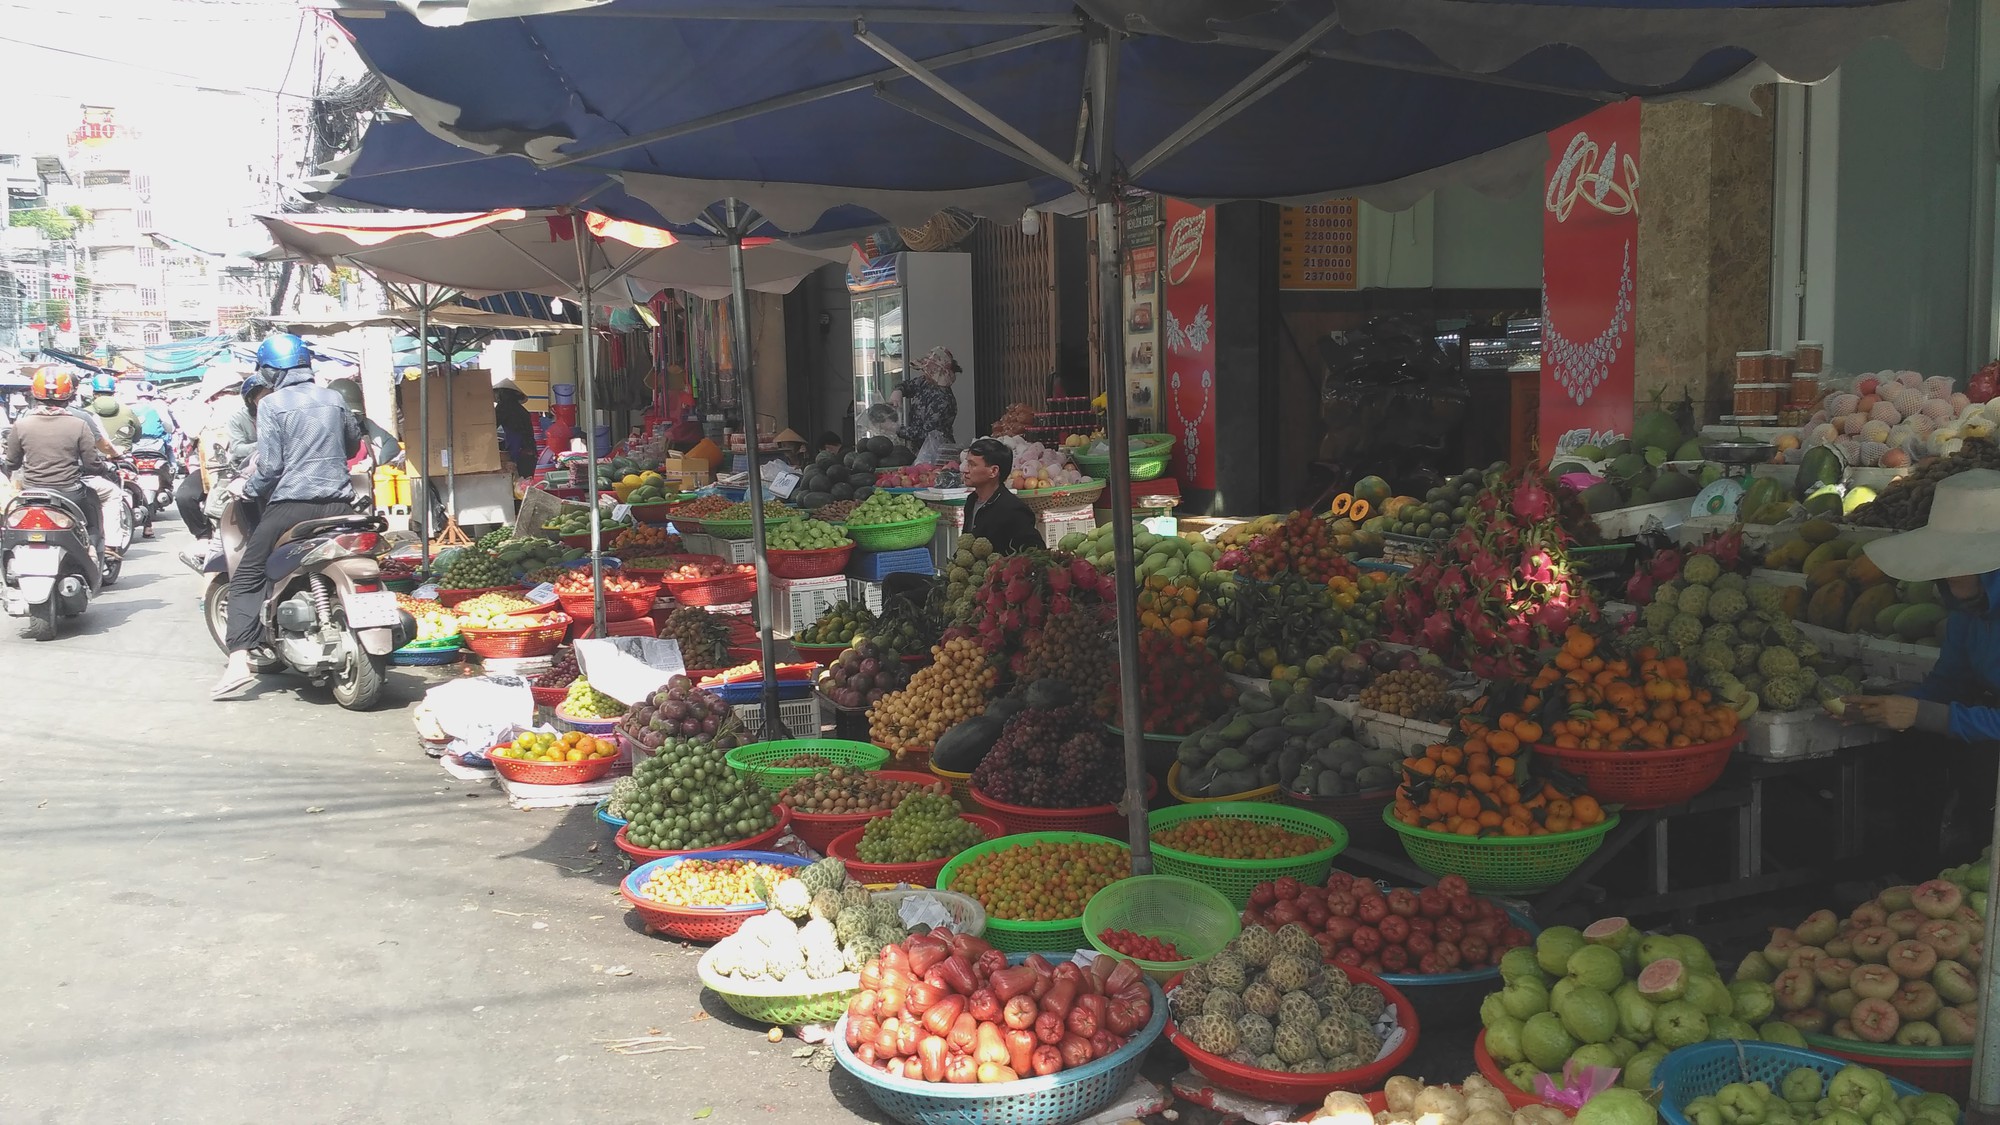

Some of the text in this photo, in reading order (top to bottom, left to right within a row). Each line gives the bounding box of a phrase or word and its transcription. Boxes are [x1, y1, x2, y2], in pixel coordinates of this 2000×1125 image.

[1304, 205, 1353, 215] 2600000
[1305, 218, 1353, 228] 2800000
[1304, 231, 1353, 241] 2280000
[1304, 245, 1352, 254] 2470000
[1304, 272, 1352, 281] 2370000
